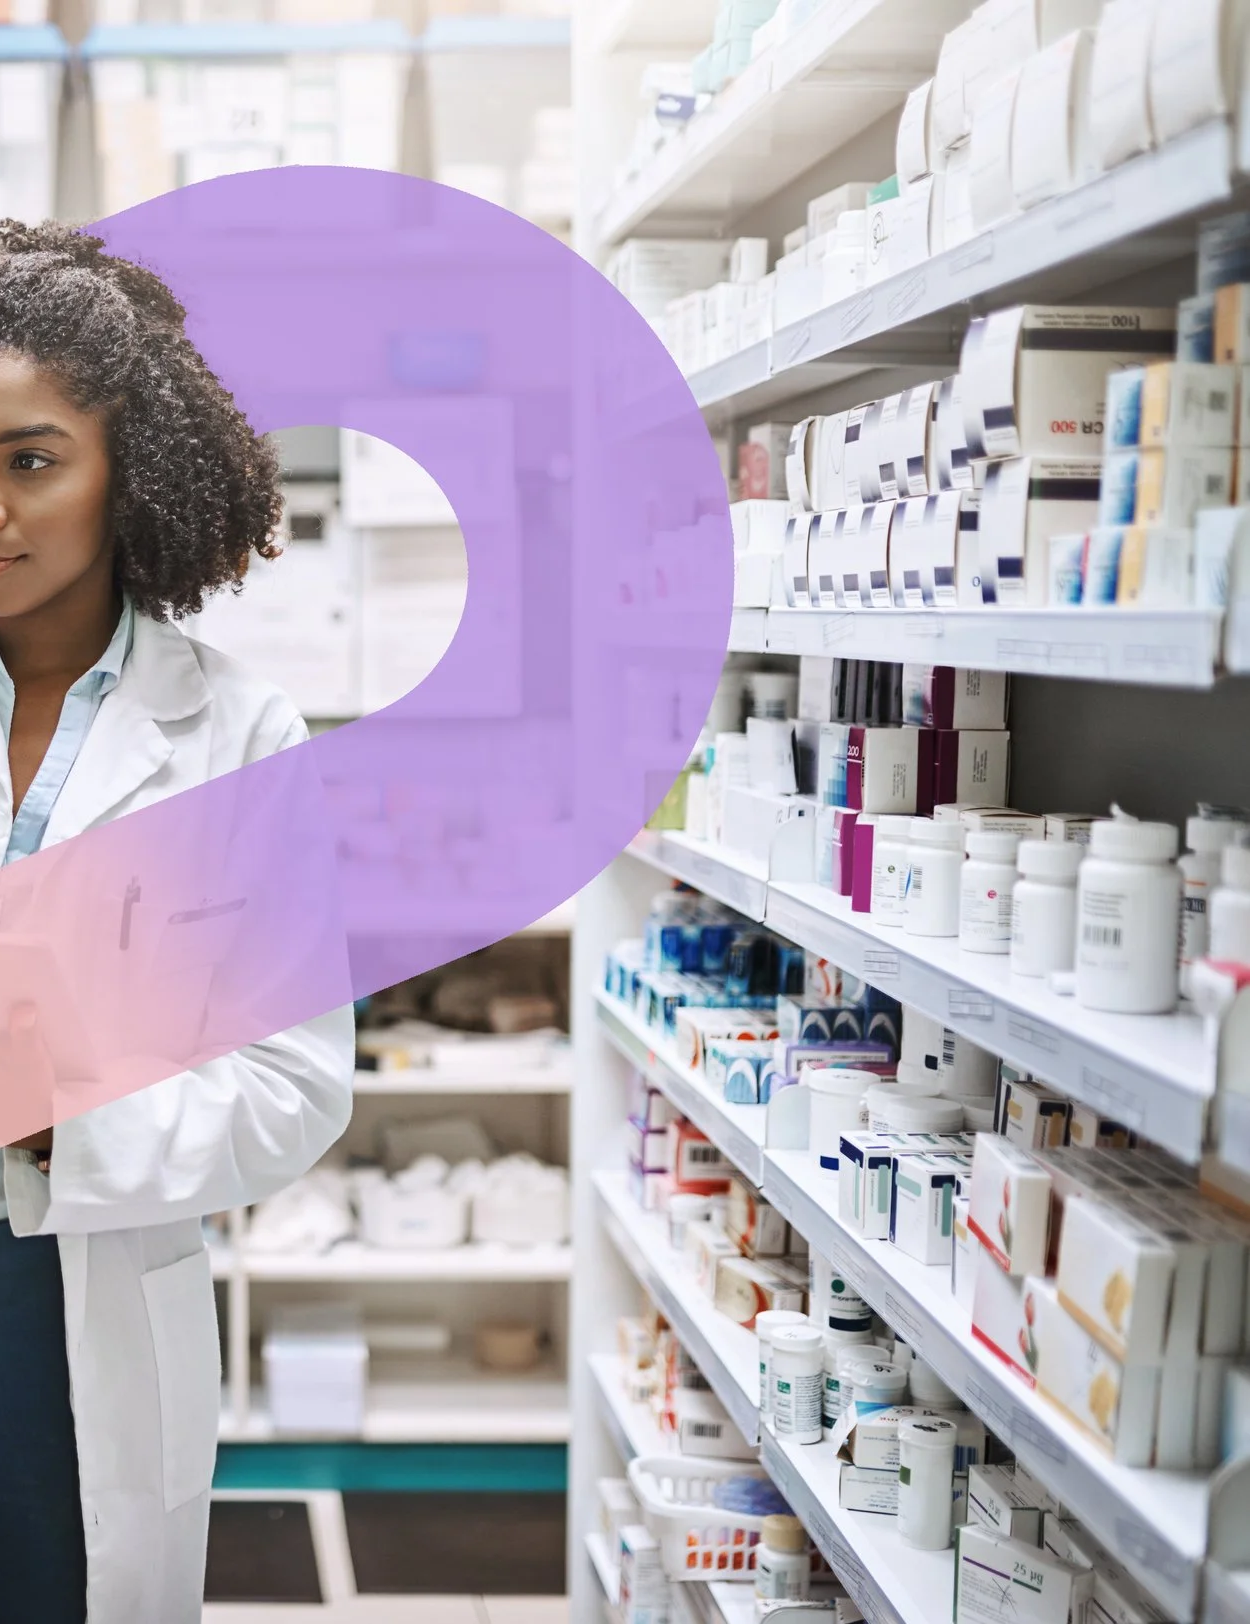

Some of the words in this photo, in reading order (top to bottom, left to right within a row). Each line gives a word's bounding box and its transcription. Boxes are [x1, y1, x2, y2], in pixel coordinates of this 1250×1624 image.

[1051, 420, 1077, 434] 500
[847, 745, 860, 757] 200
[1013, 1561, 1027, 1576] 25
